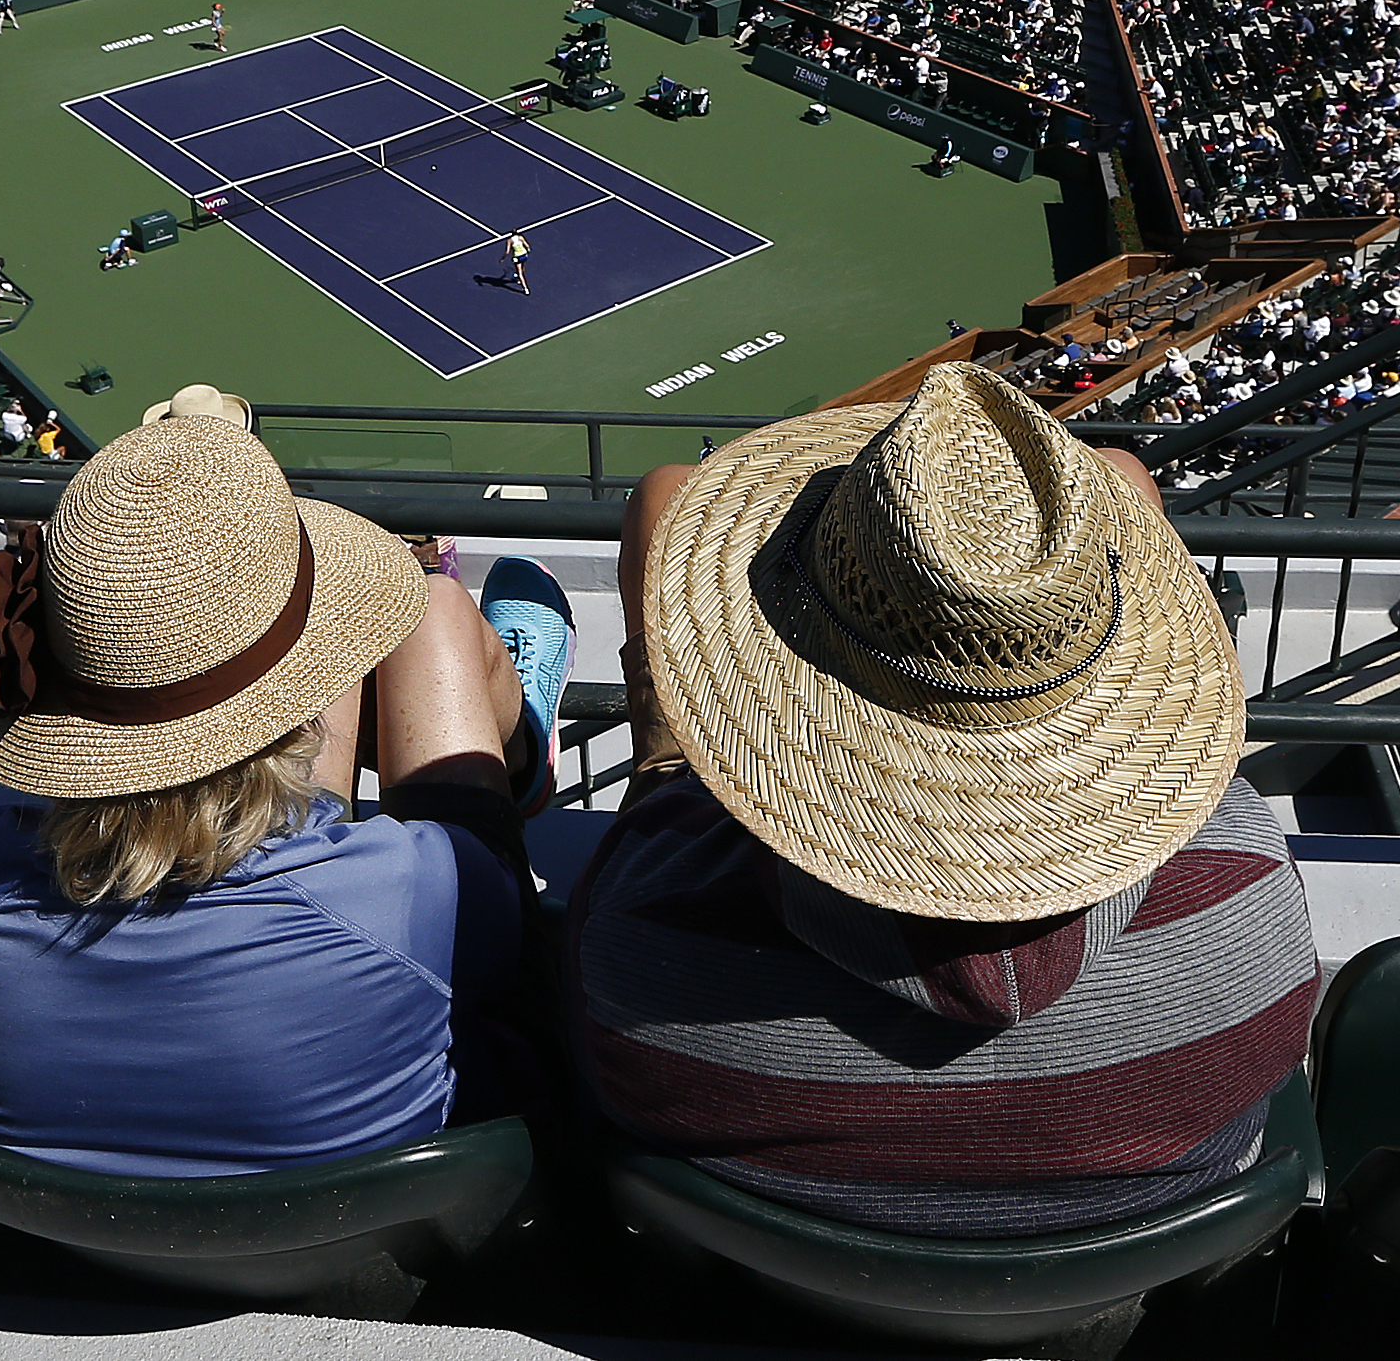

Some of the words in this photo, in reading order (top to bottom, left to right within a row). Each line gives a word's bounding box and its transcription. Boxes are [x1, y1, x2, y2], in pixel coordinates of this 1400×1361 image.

[101, 33, 154, 52] INDIAN
[162, 18, 213, 35] WELLS
[795, 65, 829, 86] TENNIS
[592, 86, 610, 98] FILA
[519, 95, 540, 107] WTA
[899, 111, 927, 127] pepsi
[204, 196, 229, 210] WTA
[645, 363, 716, 399] INDIAN
[720, 331, 786, 364] WELLS
